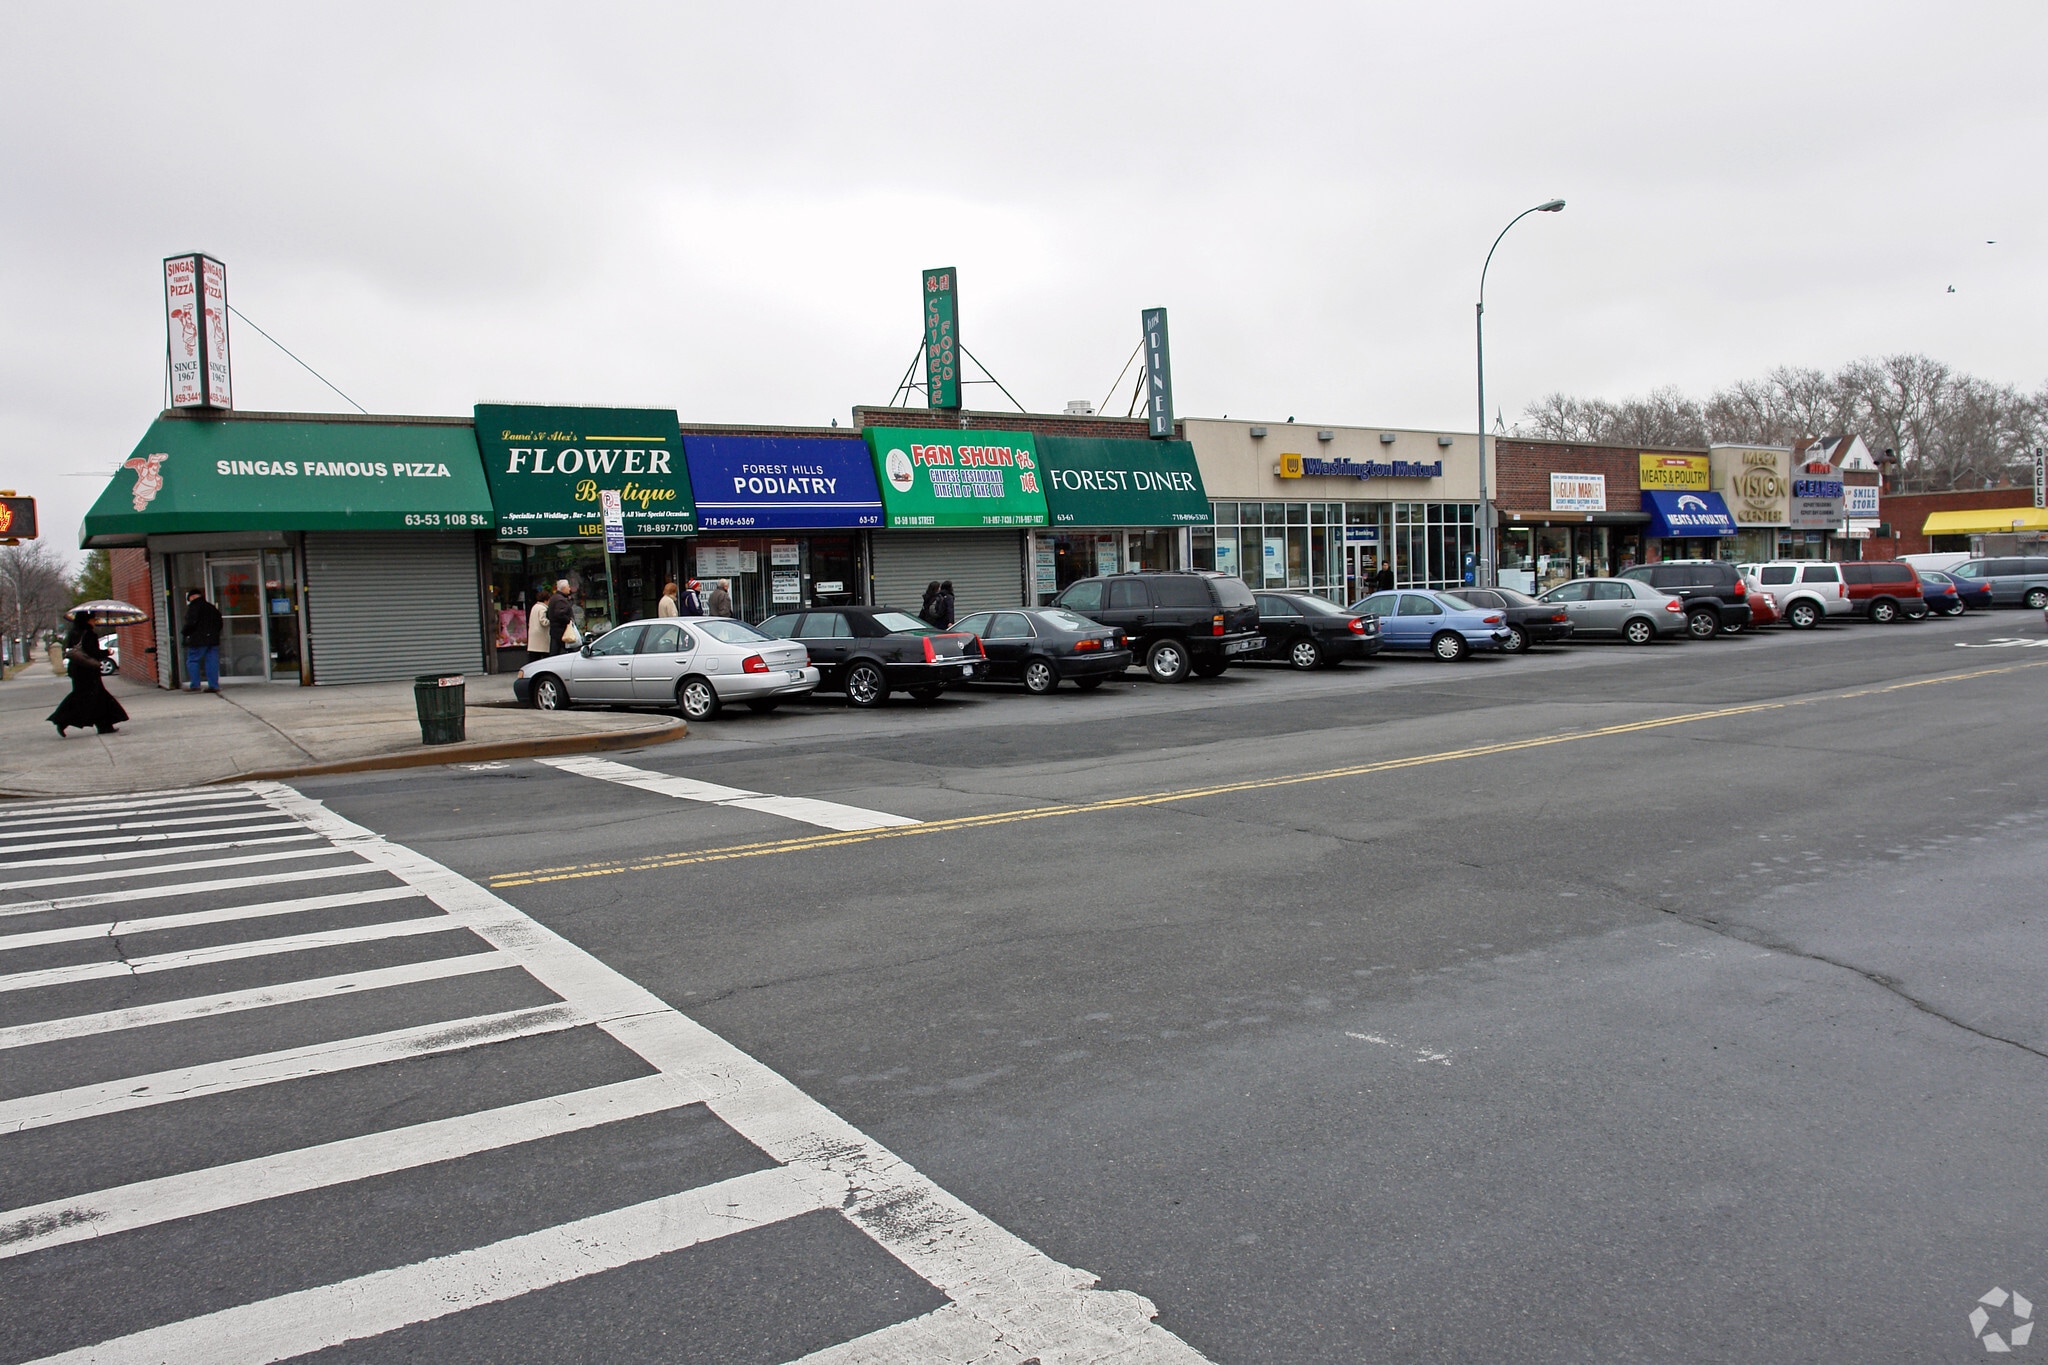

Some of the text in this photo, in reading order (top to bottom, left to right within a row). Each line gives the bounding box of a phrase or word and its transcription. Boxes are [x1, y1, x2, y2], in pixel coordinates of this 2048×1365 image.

[168, 260, 194, 277] SINGAS
[203, 261, 222, 280] SINGAS
[170, 282, 194, 297] PIZZA
[204, 282, 223, 300] PIZZA
[928, 298, 943, 404] CHINESE
[941, 321, 953, 380] FOOD
[174, 361, 198, 372] SINCE
[209, 362, 228, 374] SINCE
[178, 372, 195, 382] 1967
[212, 373, 226, 383] 1967
[1150, 332, 1166, 432] DINER
[175, 392, 200, 402] 459-3441
[506, 448, 672, 474] FLOWER
[910, 444, 1013, 468] FAN SHUN
[1742, 451, 1778, 466] MEGA
[216, 460, 451, 478] SINGAS FAMOUS PIZZA
[743, 464, 824, 474] FOREST HILLS
[930, 469, 1004, 483] CHINESE RESTAURANT
[1302, 457, 1442, 480] Washington Mutual
[1050, 470, 1197, 491] FOREST DINER
[1642, 470, 1707, 484] MEATS & POULTRY
[2036, 447, 2044, 506] BAGELS
[734, 477, 836, 494] PODIATRY
[934, 484, 952, 497] DINE
[972, 484, 990, 497] TAKE
[990, 484, 1004, 497] OUT
[1732, 474, 1789, 498] VISION
[1794, 480, 1844, 498] CLEANERS
[1853, 488, 1876, 498] SMILE
[575, 480, 676, 509] Btique
[1852, 500, 1876, 509] STORE
[404, 514, 488, 526] 63-53 108 St.
[918, 516, 935, 525] STREET
[1667, 514, 1692, 525] MEATS
[1698, 514, 1730, 525] POULTRY
[1738, 510, 1782, 522] CENTER
[501, 526, 528, 535] 63-55
[638, 524, 694, 532] 718-897-7100
